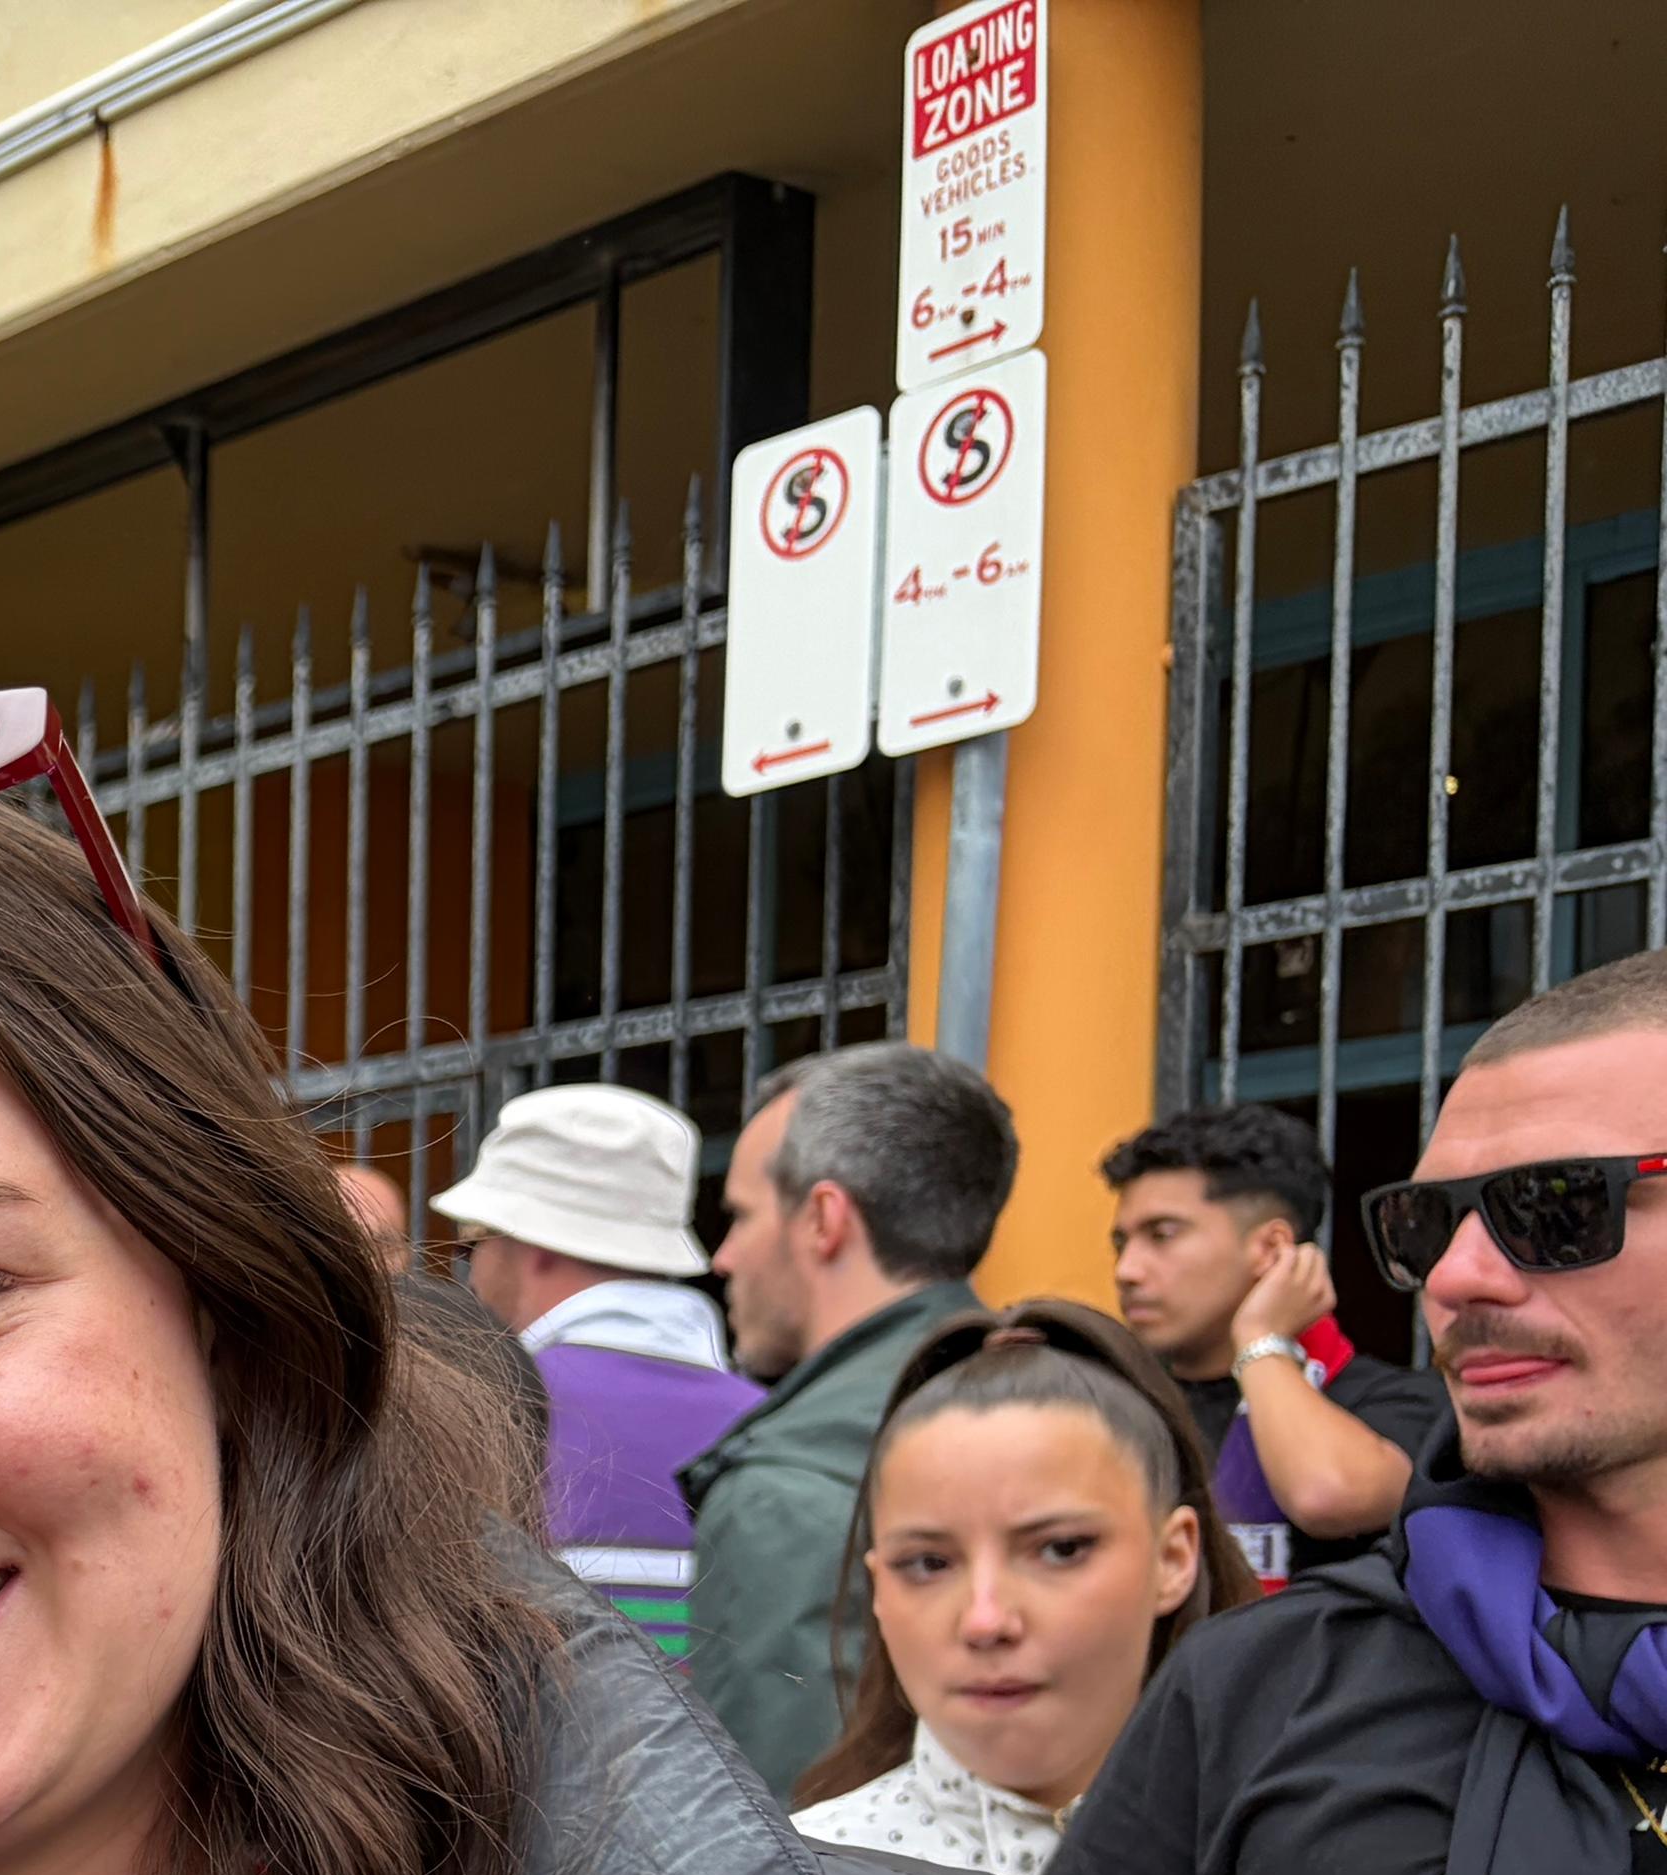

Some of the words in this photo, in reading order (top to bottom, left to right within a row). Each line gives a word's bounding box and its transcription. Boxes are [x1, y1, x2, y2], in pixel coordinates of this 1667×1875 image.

[917, 1, 1034, 99] LOADING
[921, 57, 1026, 148] ZONE
[921, 152, 1026, 218] VEHICLES
[936, 130, 1011, 182] GOODS
[939, 216, 973, 263] 15
